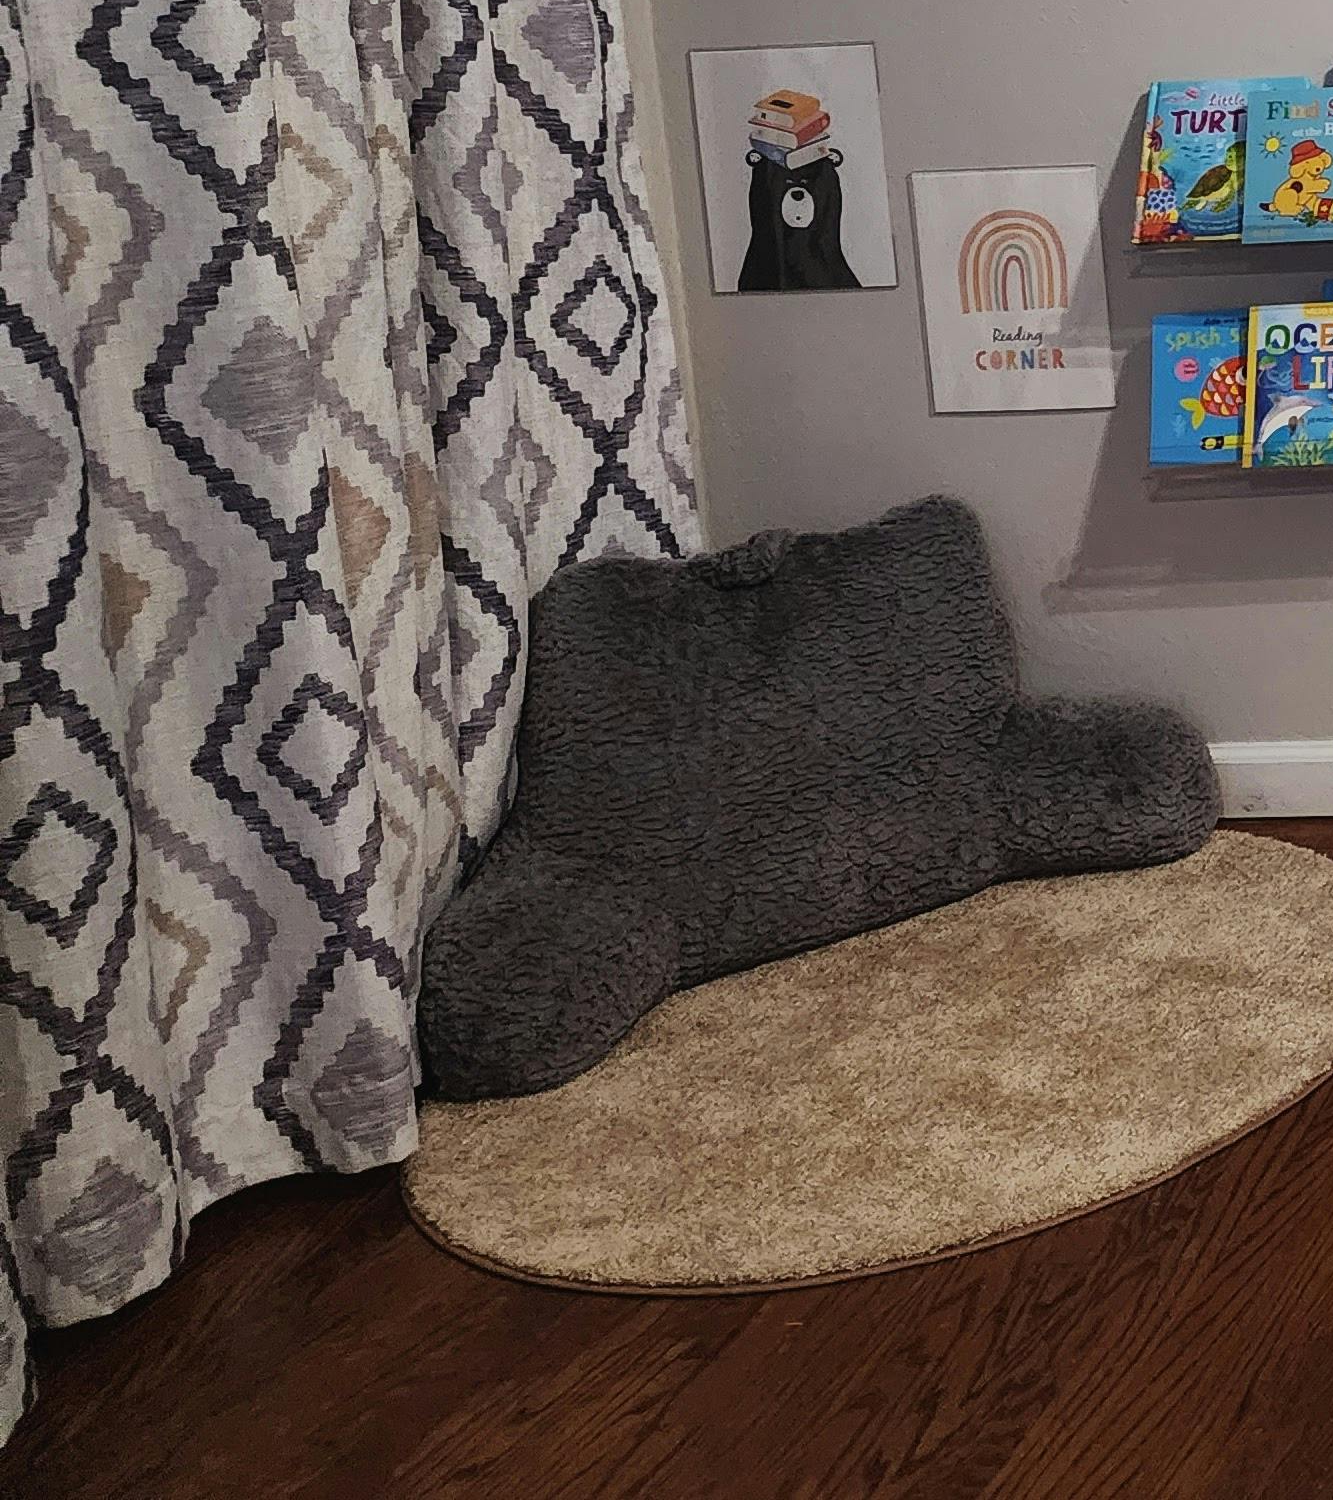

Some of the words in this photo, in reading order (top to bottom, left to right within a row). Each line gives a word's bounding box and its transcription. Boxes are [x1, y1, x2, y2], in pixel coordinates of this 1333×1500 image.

[1209, 93, 1246, 107] Little
[1266, 100, 1320, 121] Find
[991, 325, 1044, 346] Reading
[975, 346, 1066, 372] CORNER
